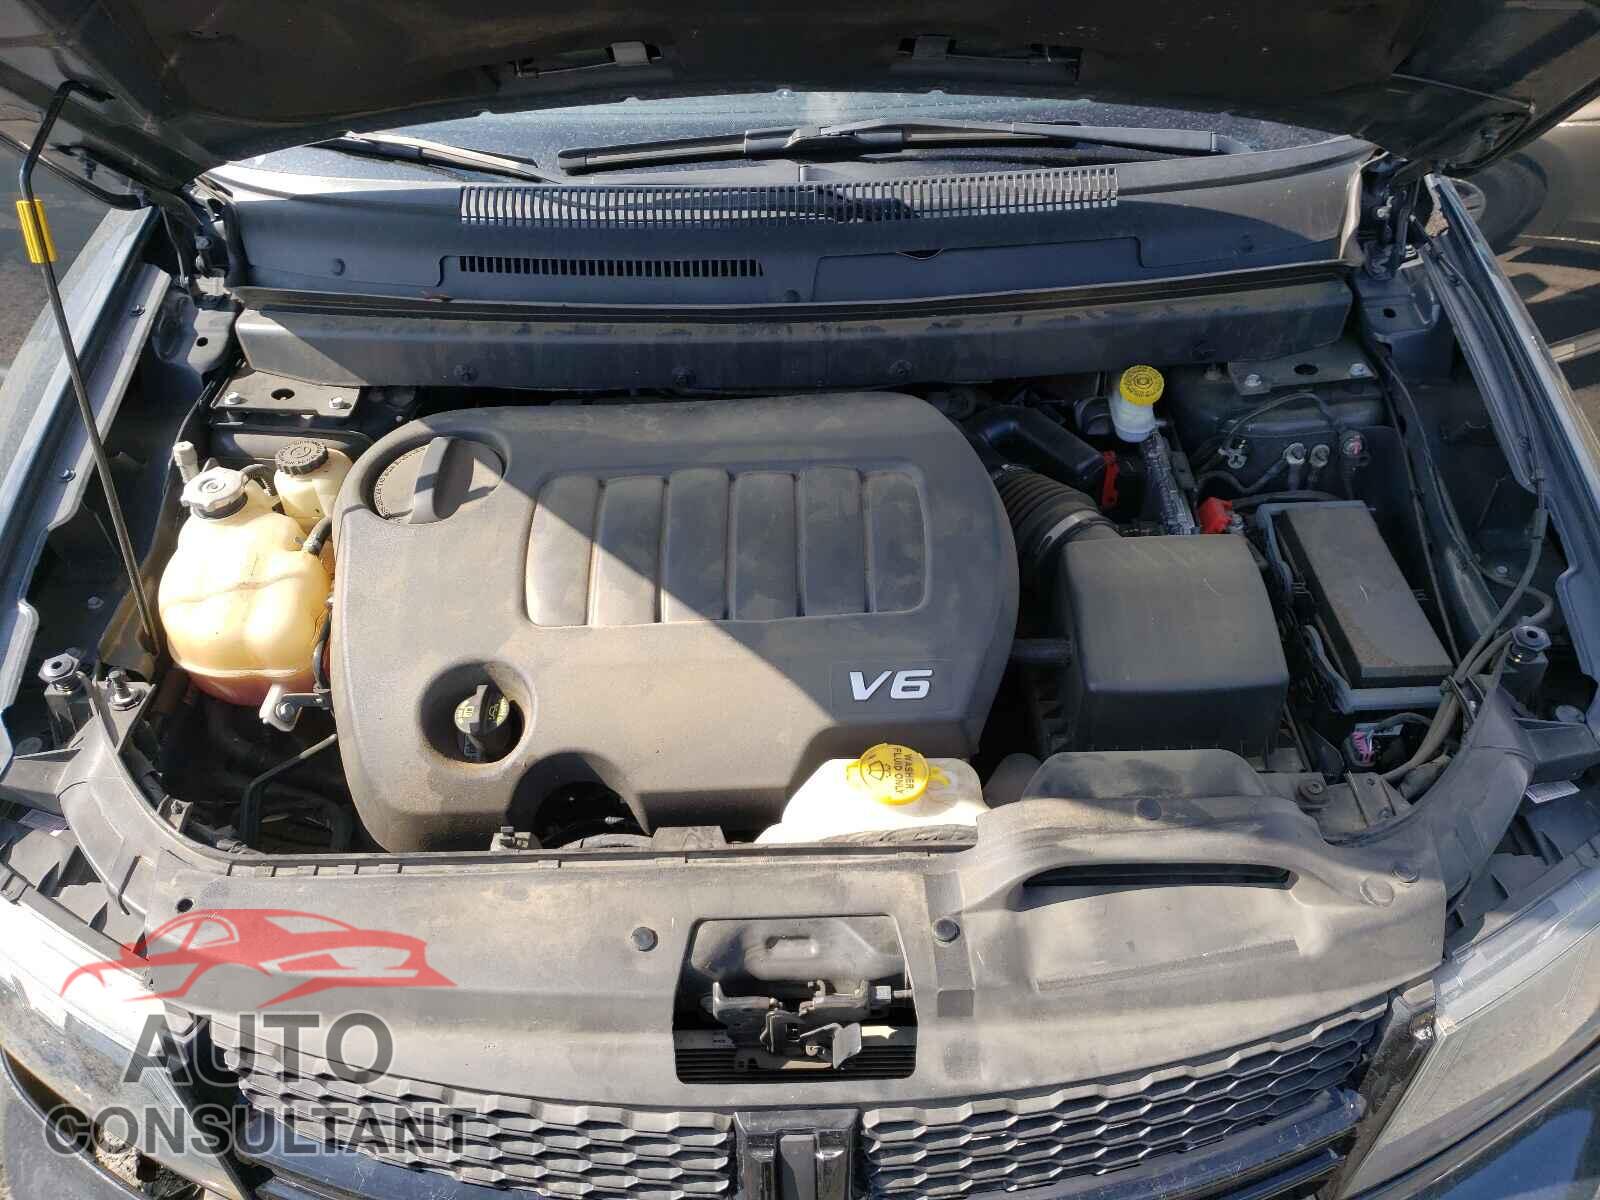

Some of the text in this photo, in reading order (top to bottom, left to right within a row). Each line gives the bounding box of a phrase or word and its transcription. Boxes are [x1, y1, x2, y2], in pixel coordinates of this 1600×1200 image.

[849, 669, 933, 701] V6
[893, 748, 905, 793] FLUID ONLY
[904, 753, 914, 789] WASHER
